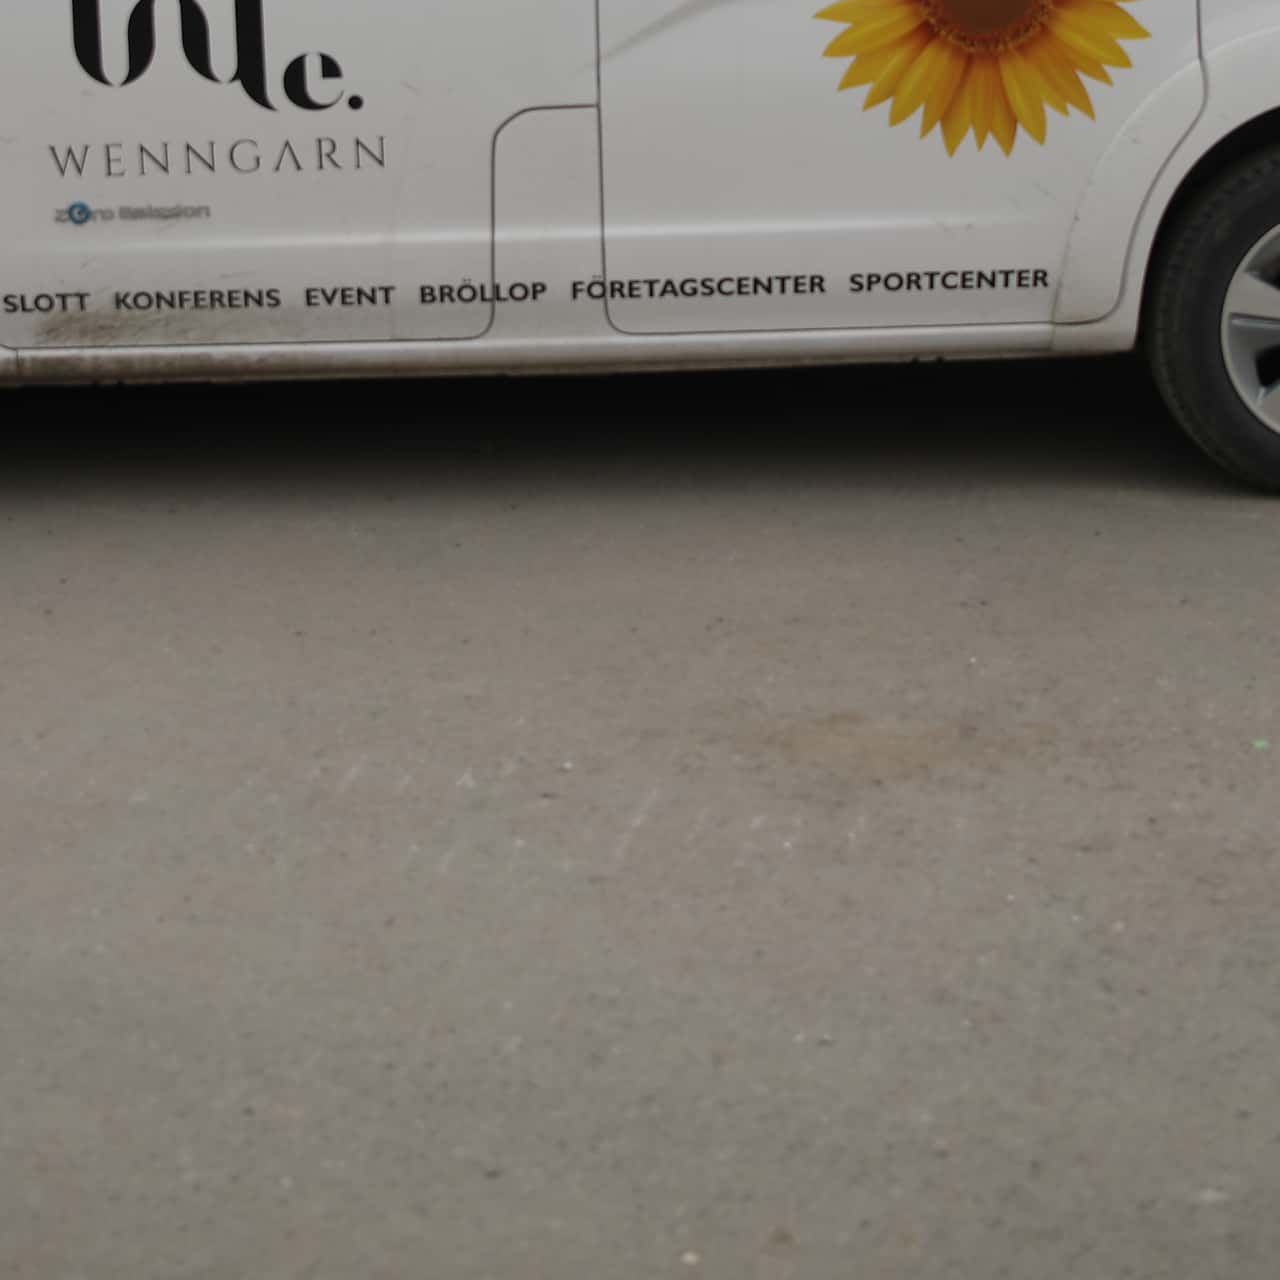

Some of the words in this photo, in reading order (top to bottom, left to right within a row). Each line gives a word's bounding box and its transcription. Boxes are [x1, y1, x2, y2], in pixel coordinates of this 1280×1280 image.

[48, 135, 387, 177] WENNGARN
[2, 291, 91, 313] SLOTT
[114, 288, 282, 311] KONFERENS
[305, 285, 396, 308] EVENT
[420, 278, 548, 304] BRÖLLOP
[572, 274, 826, 301] FÖRETAGSCENTER
[849, 269, 1049, 293] SPORTCENTER
